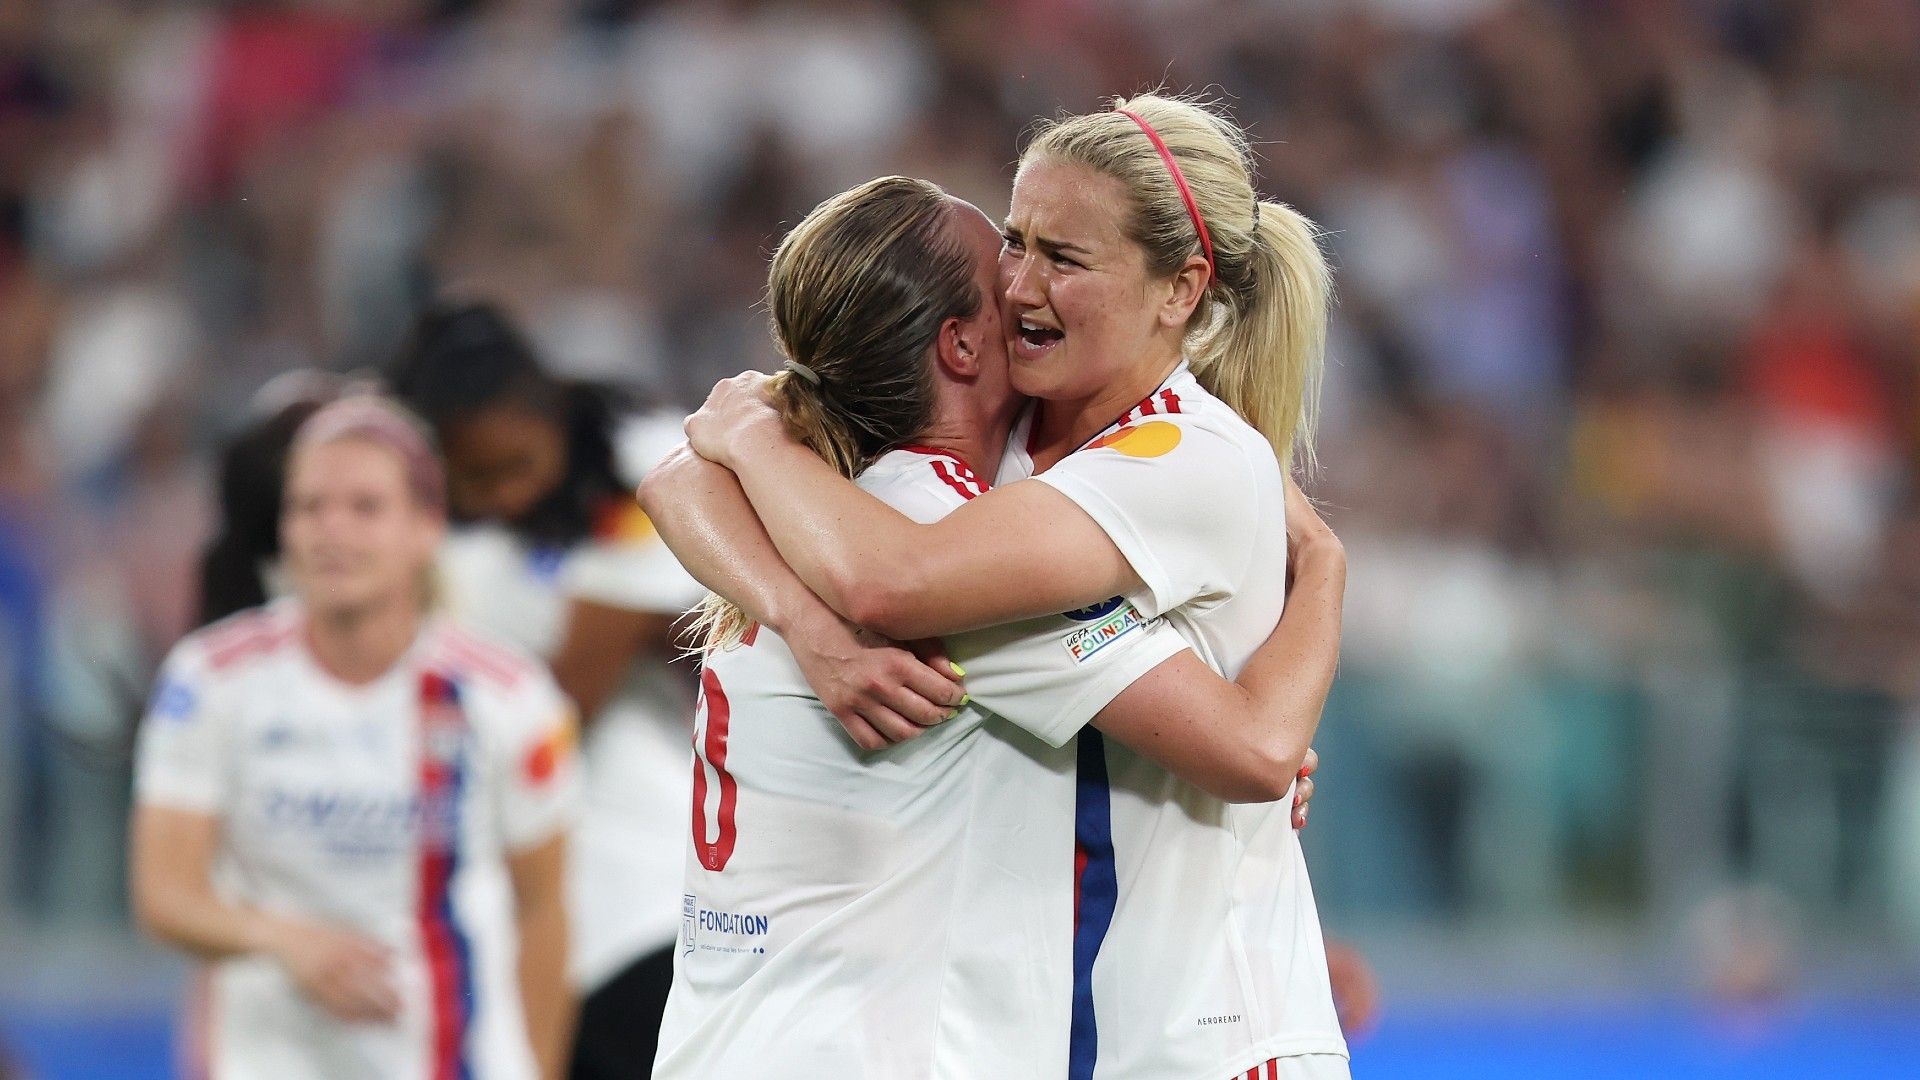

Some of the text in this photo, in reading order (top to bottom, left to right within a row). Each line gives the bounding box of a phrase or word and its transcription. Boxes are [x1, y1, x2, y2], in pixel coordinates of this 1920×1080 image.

[1066, 628, 1089, 648] UEFA
[699, 909, 768, 936] FONDATION
[1197, 1014, 1241, 1026] AEROREADY
